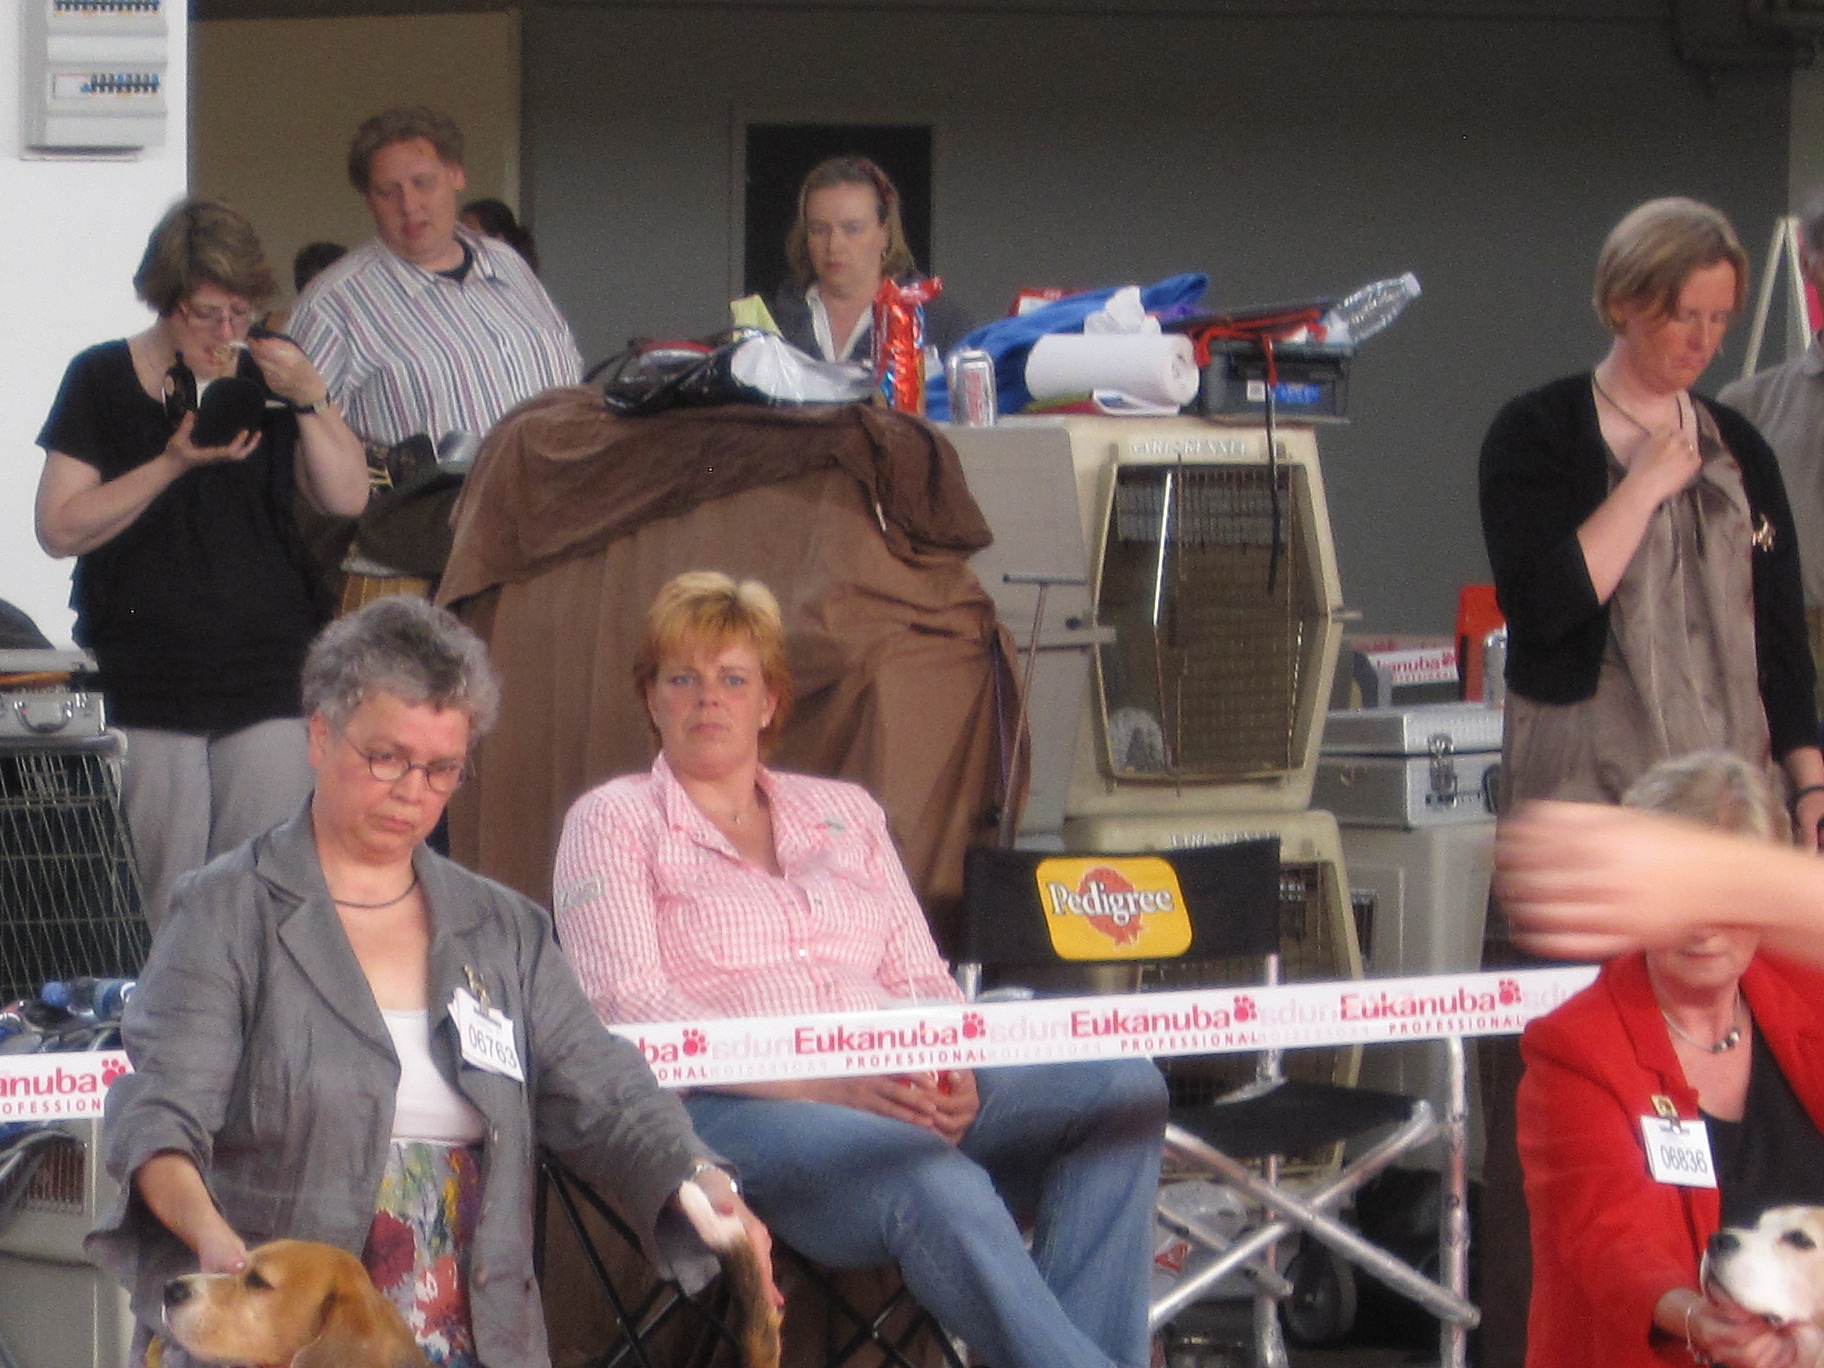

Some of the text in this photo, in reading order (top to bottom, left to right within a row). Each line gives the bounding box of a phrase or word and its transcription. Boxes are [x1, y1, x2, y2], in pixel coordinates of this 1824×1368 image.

[1047, 880, 1174, 927] Pedigree
[1071, 1004, 1230, 1038] Eukanuba
[1340, 987, 1495, 1021] Eukanuba
[795, 1021, 959, 1055] Eukanuba
[1121, 1030, 1258, 1052] PROFESSIONAL
[1389, 1015, 1524, 1036] PROFESSIONAL
[846, 1049, 987, 1070] PROFESSIONAL
